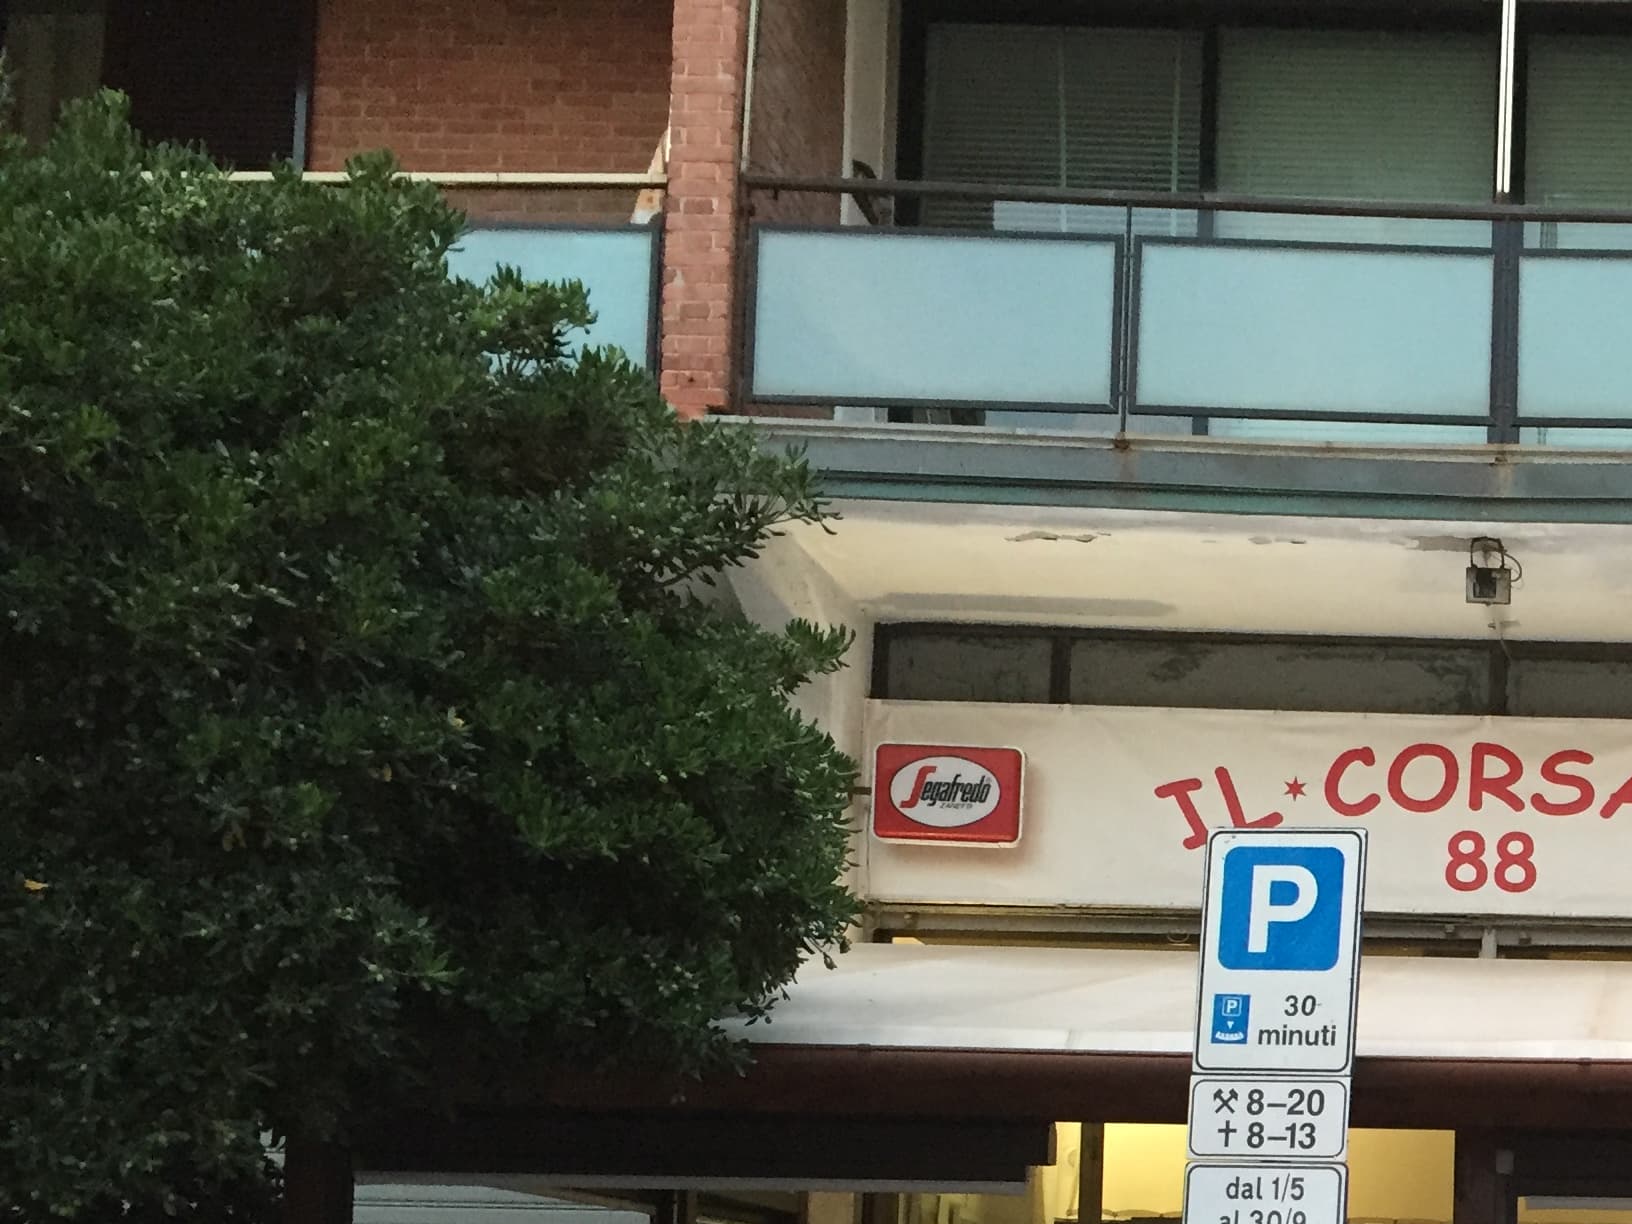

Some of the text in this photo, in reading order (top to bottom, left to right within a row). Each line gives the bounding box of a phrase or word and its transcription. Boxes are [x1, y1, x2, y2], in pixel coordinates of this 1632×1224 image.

[900, 765, 992, 807] Segafredo
[1155, 767, 1283, 849] IL
[1445, 830, 1537, 893] 88
[1247, 865, 1318, 953] P
[1226, 999, 1238, 1013] P
[1284, 994, 1317, 1017] 30
[1258, 1024, 1336, 1047] minuti
[1225, 1173, 1305, 1202] dal 1/5
